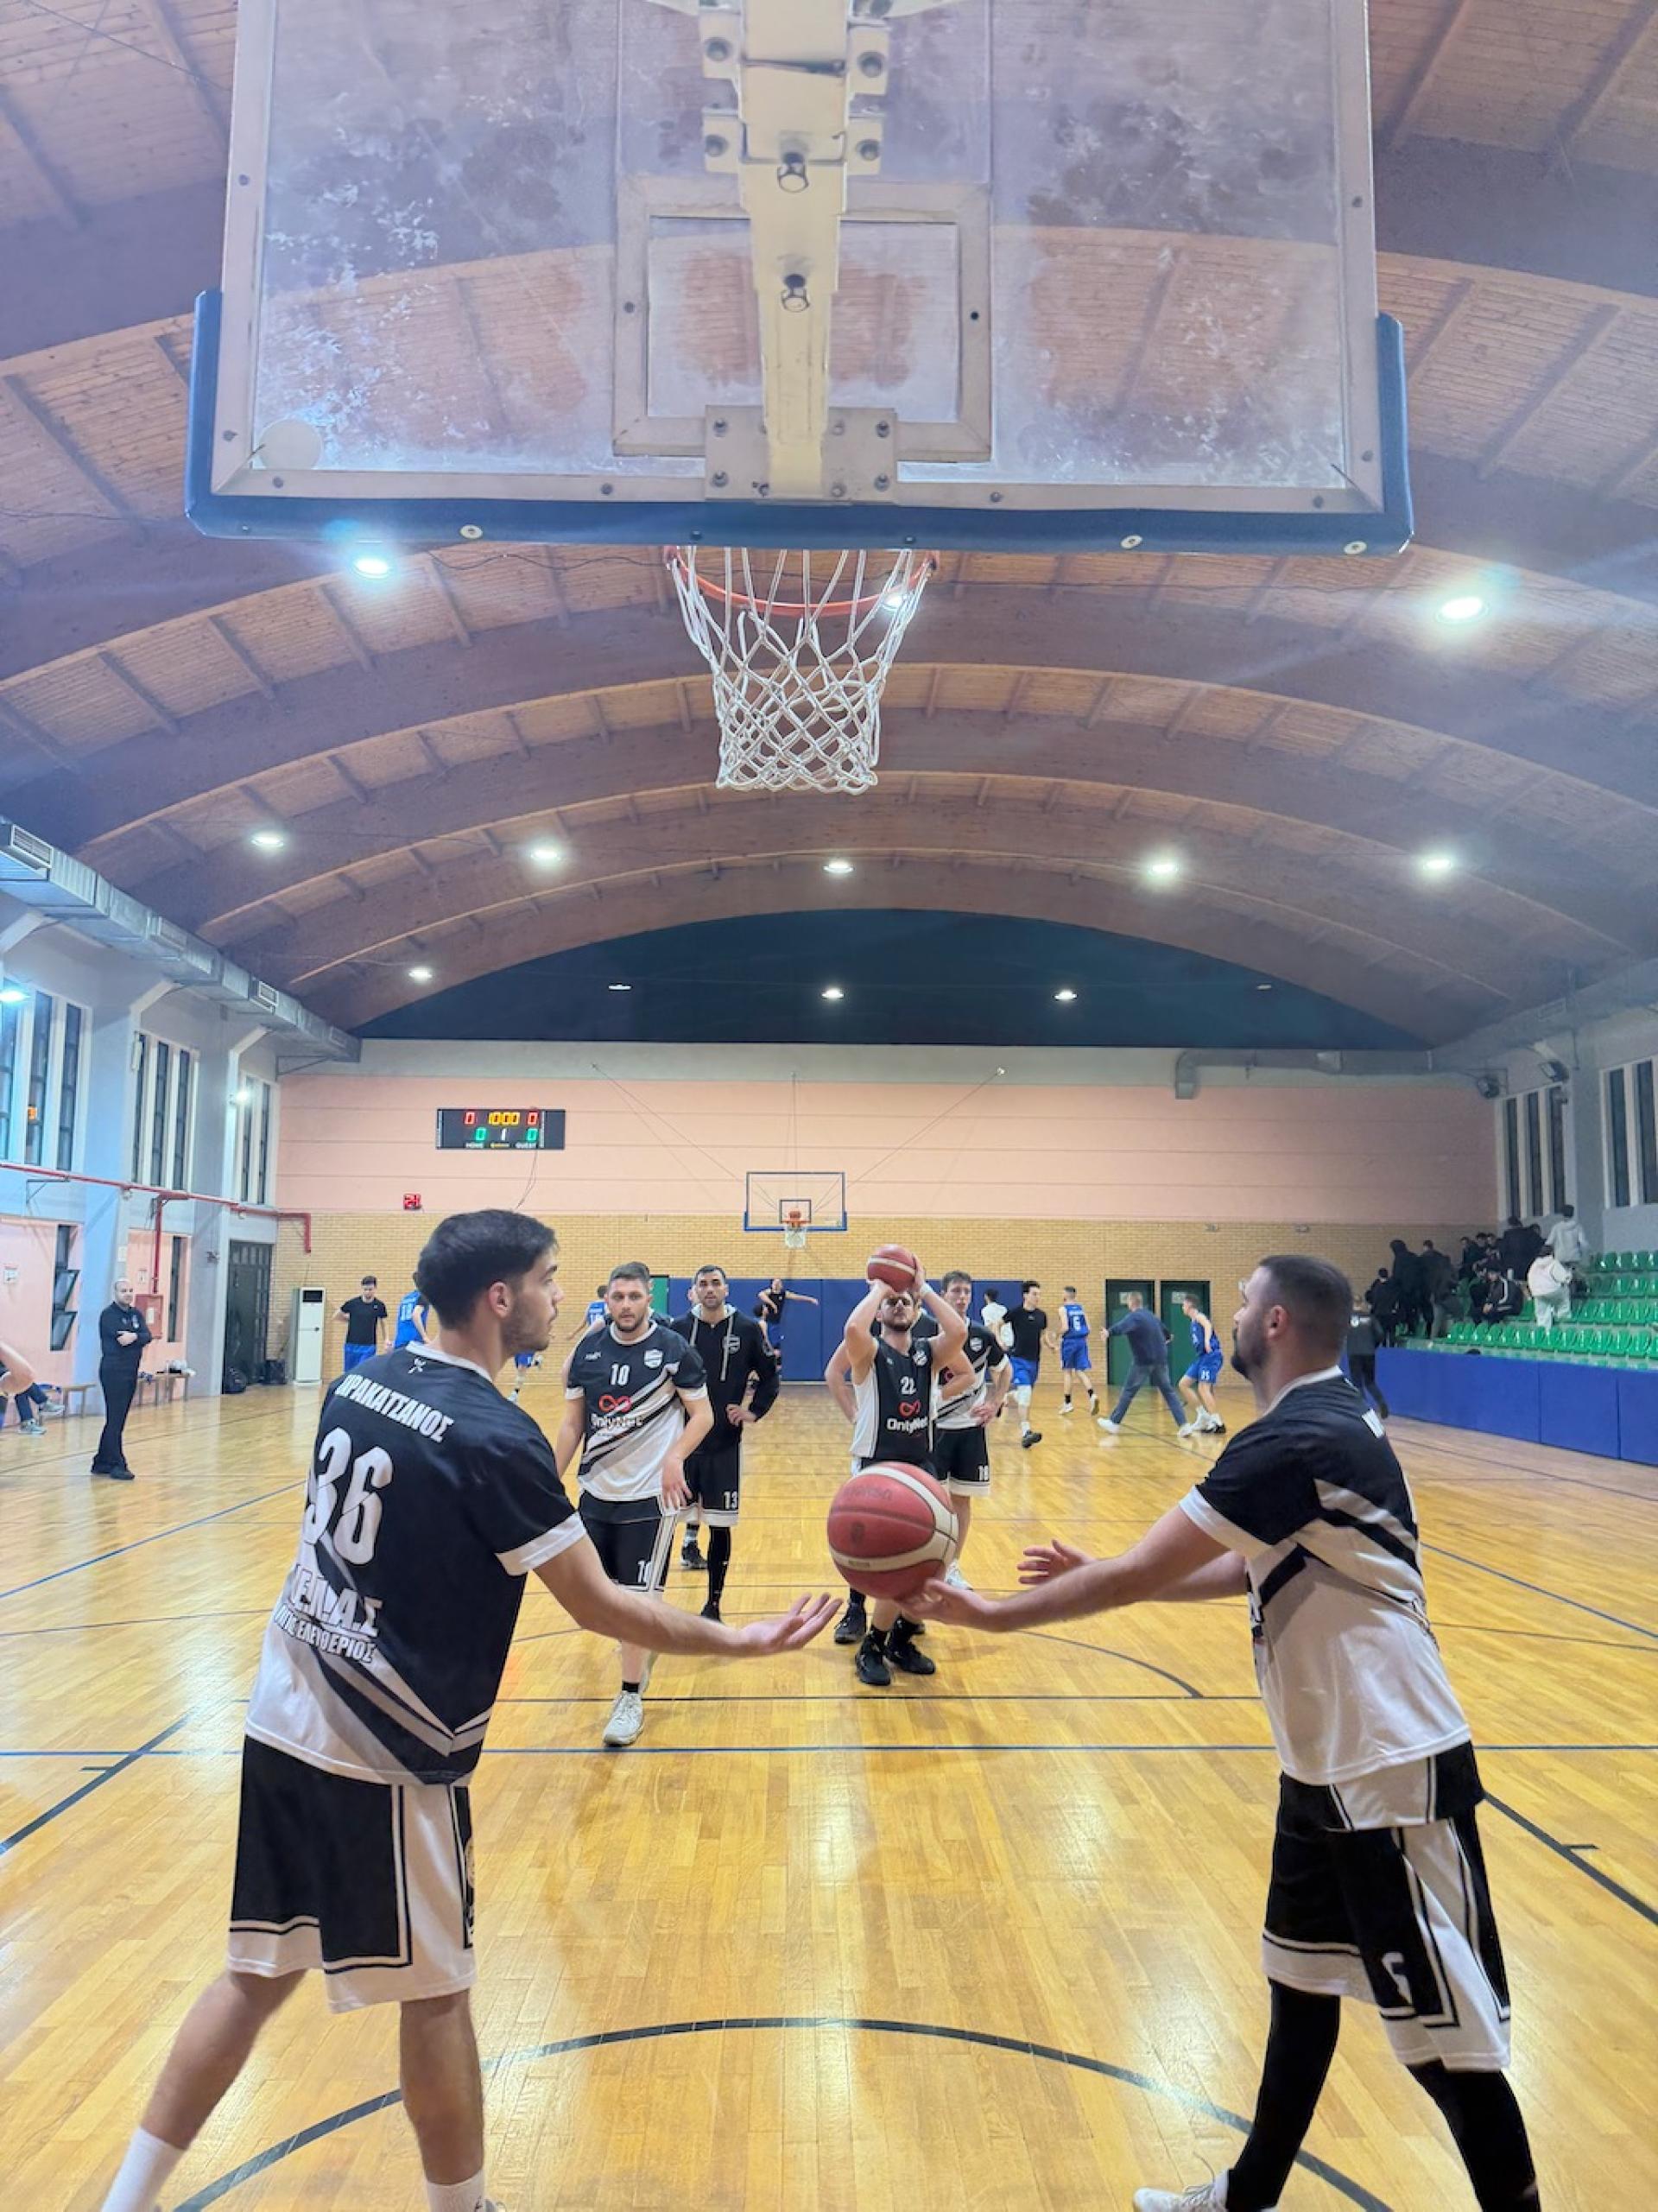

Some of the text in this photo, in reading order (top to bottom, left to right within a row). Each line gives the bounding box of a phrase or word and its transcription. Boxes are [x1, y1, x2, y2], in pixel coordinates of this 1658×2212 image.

[465, 1112, 476, 1125] 0
[527, 1112, 539, 1125] 0
[475, 1127, 487, 1141] 0
[527, 1127, 539, 1141] 0
[611, 1364, 630, 1385] 10
[303, 1427, 394, 1566] 36
[724, 1491, 738, 1510] 13
